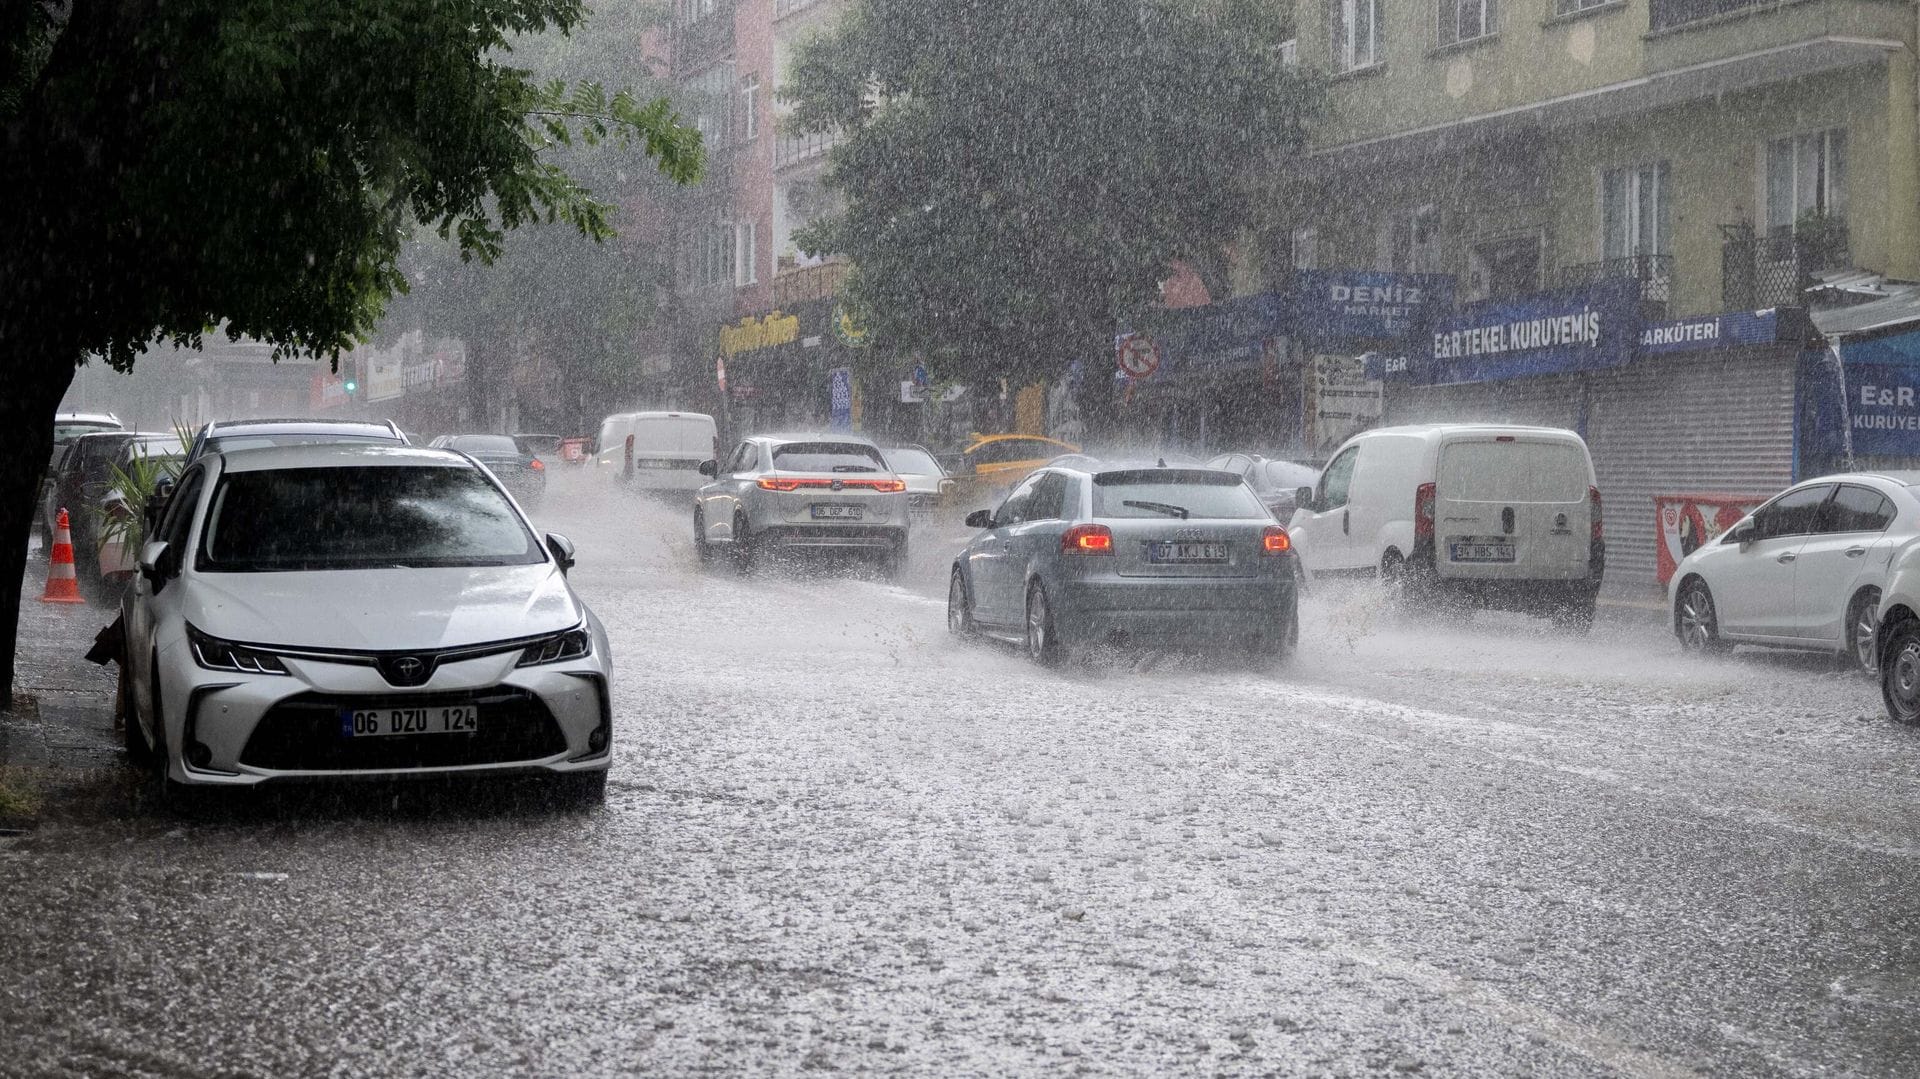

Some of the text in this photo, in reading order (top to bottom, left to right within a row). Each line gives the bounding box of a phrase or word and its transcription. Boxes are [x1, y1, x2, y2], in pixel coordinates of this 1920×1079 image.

[1331, 284, 1421, 303] DENİZ
[1344, 305, 1411, 317] MARKET
[1434, 305, 1600, 359] E&R TEKEL KURUYEMİŞ
[1640, 317, 1720, 345] ARKÜTERİ
[1385, 356, 1407, 372] E&R
[1861, 385, 1915, 407] E&R
[1854, 414, 1920, 431] KURUYE
[1158, 545, 1172, 558] 07
[1474, 546, 1492, 557] HBS
[354, 711, 378, 734] 06
[391, 709, 428, 733] DZU
[442, 708, 476, 731] 124
